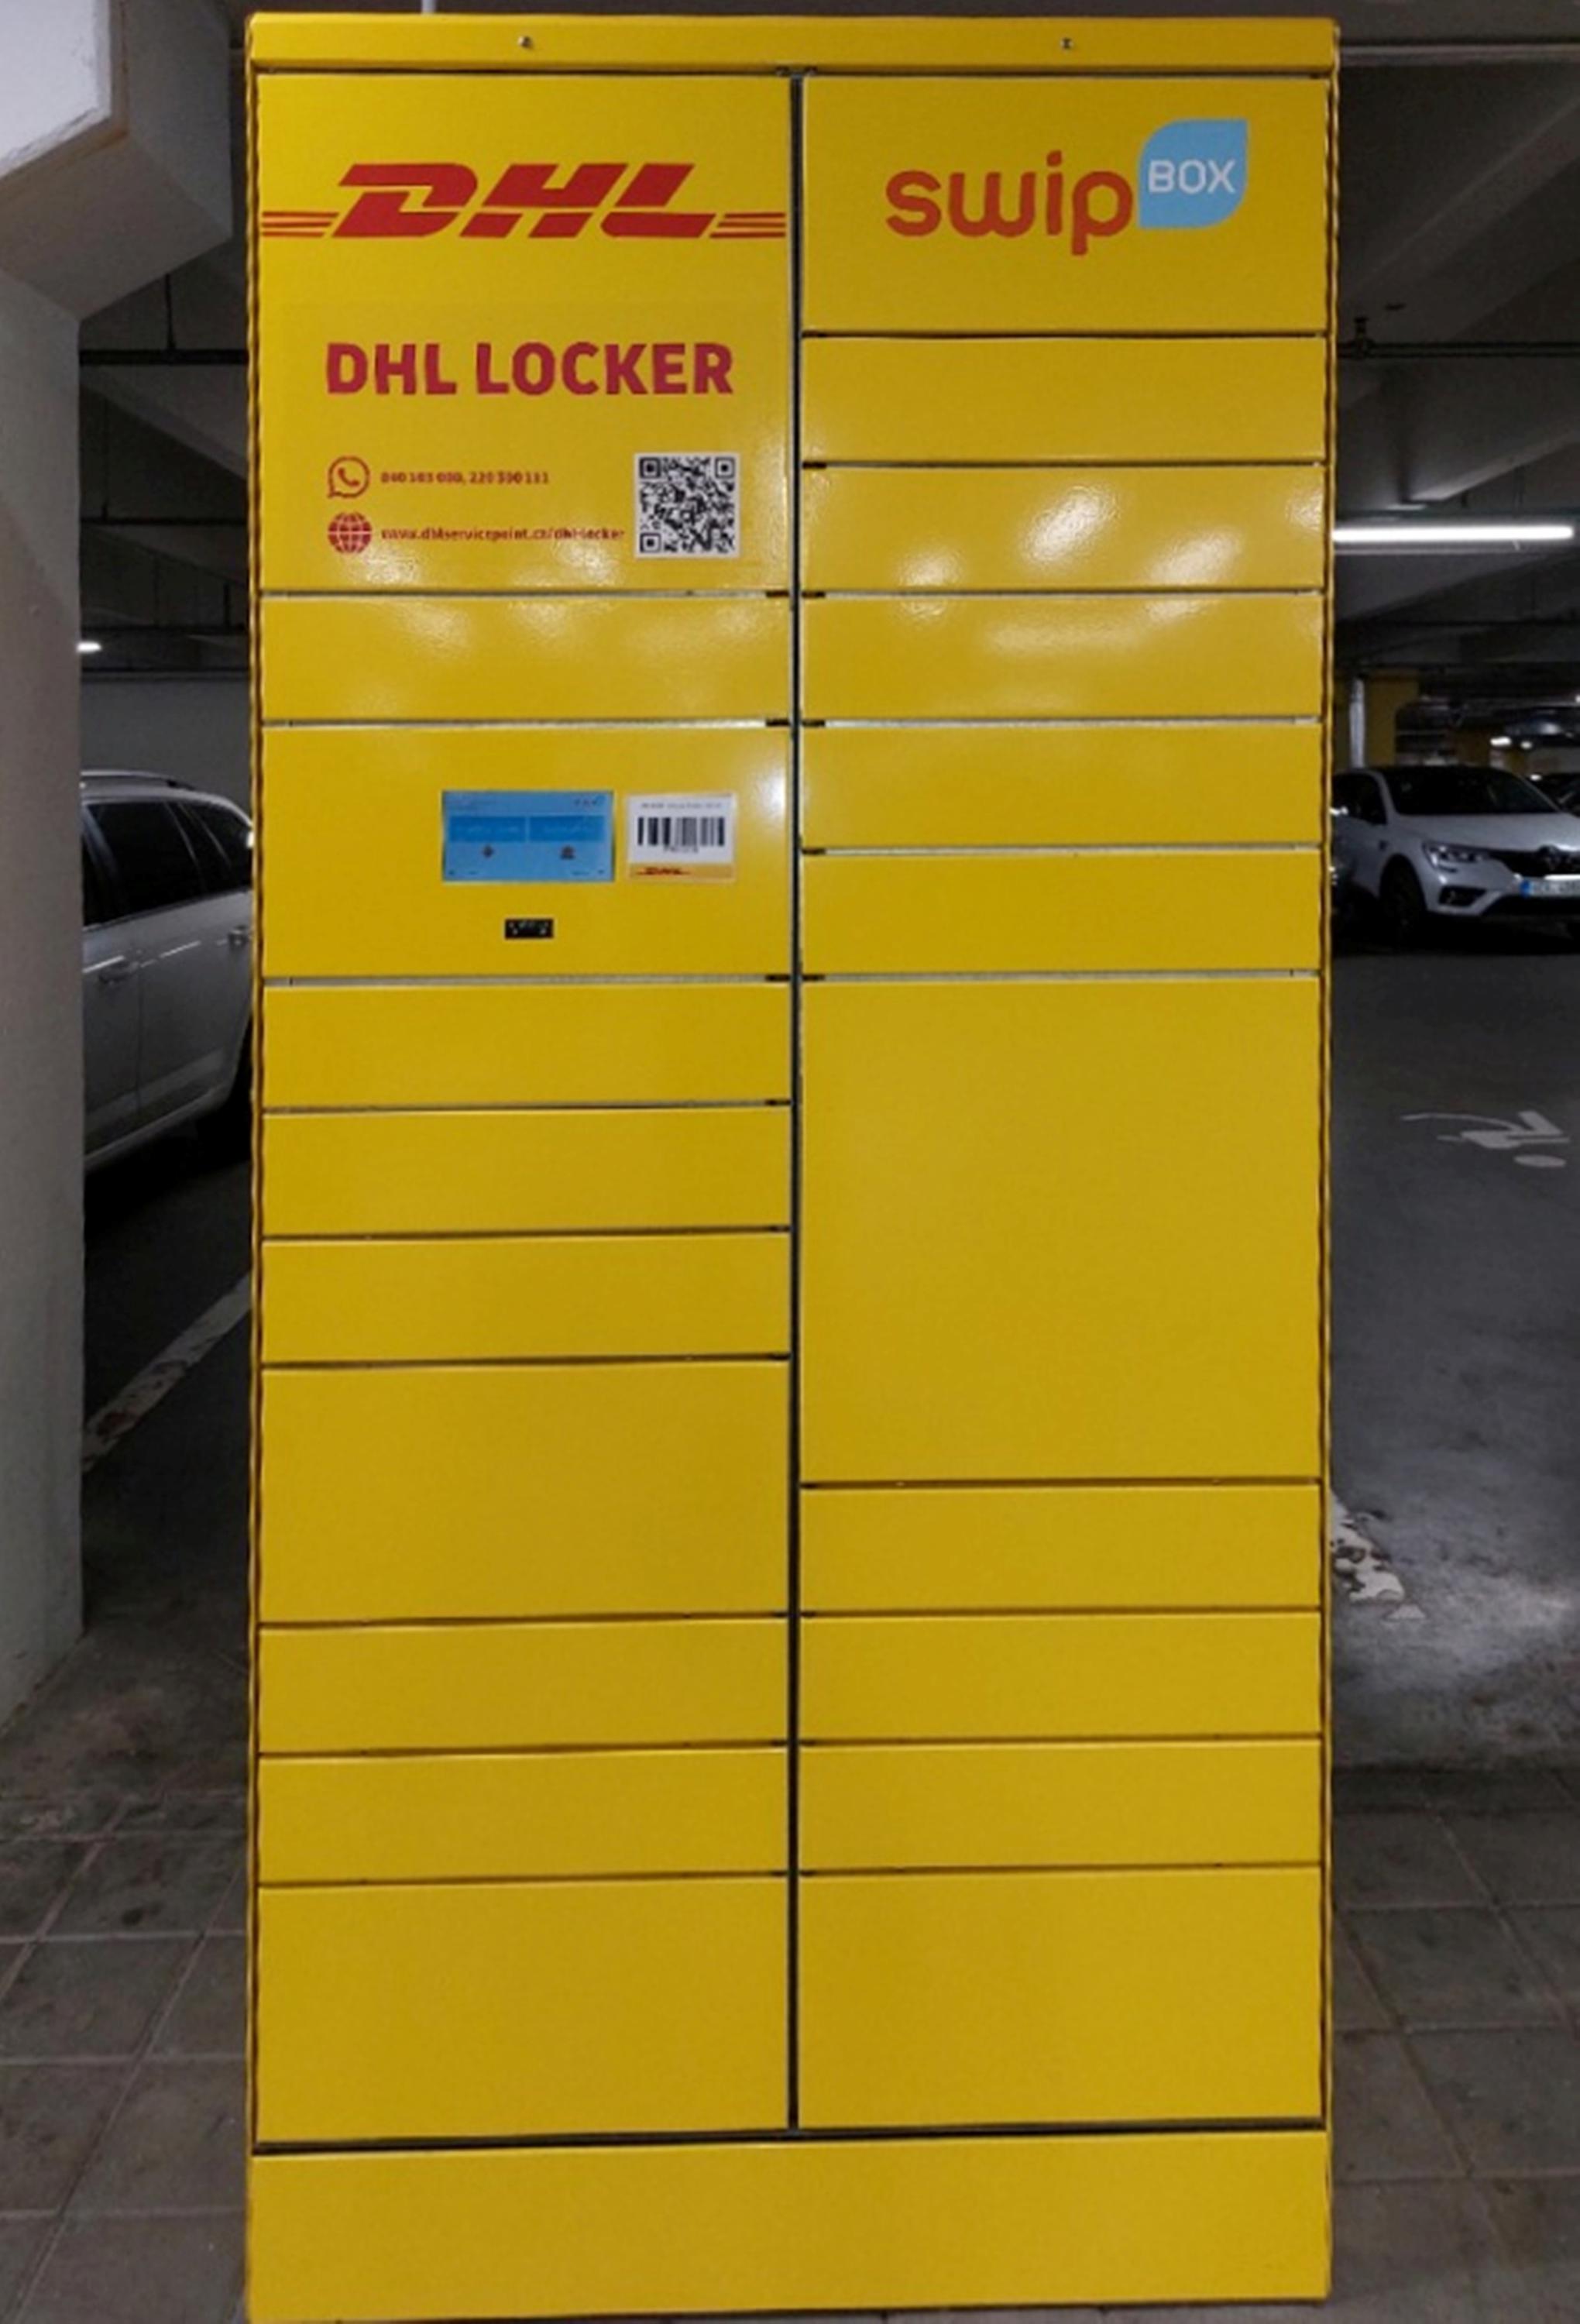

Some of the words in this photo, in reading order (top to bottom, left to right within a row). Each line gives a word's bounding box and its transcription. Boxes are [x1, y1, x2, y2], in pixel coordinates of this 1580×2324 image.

[331, 163, 717, 239] DHL
[886, 150, 1133, 256] swip
[1148, 159, 1236, 194] BOX
[326, 342, 458, 395] DHL
[476, 342, 733, 396] LOCKER
